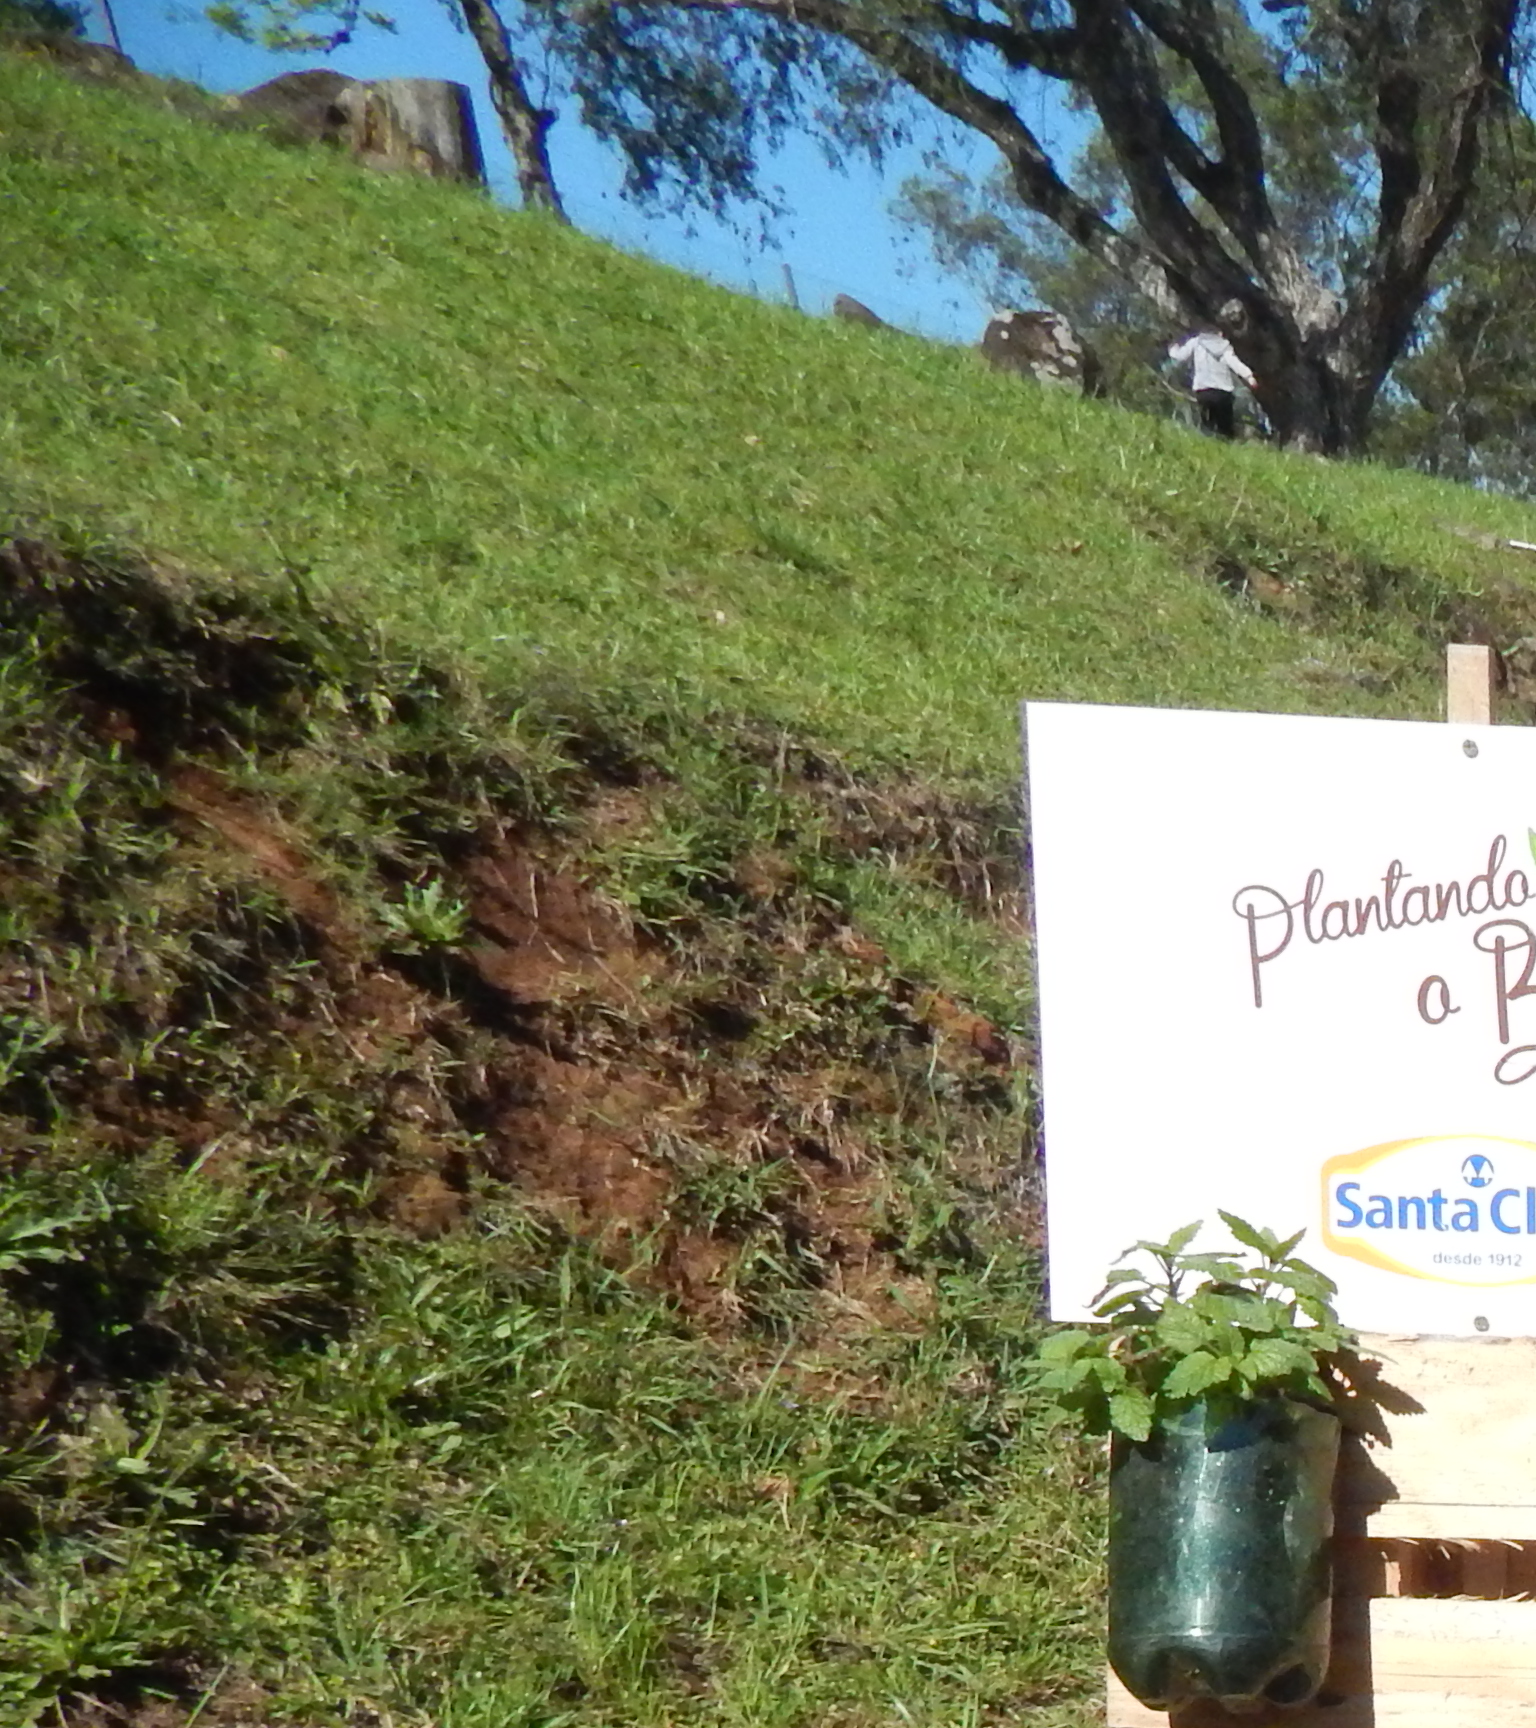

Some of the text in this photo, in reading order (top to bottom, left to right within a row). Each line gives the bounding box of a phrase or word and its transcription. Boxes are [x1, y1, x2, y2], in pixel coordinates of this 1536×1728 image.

[1231, 833, 1536, 1009] Plantando
[1335, 1181, 1480, 1233] Santa
[1432, 1252, 1523, 1267] desde 1912
